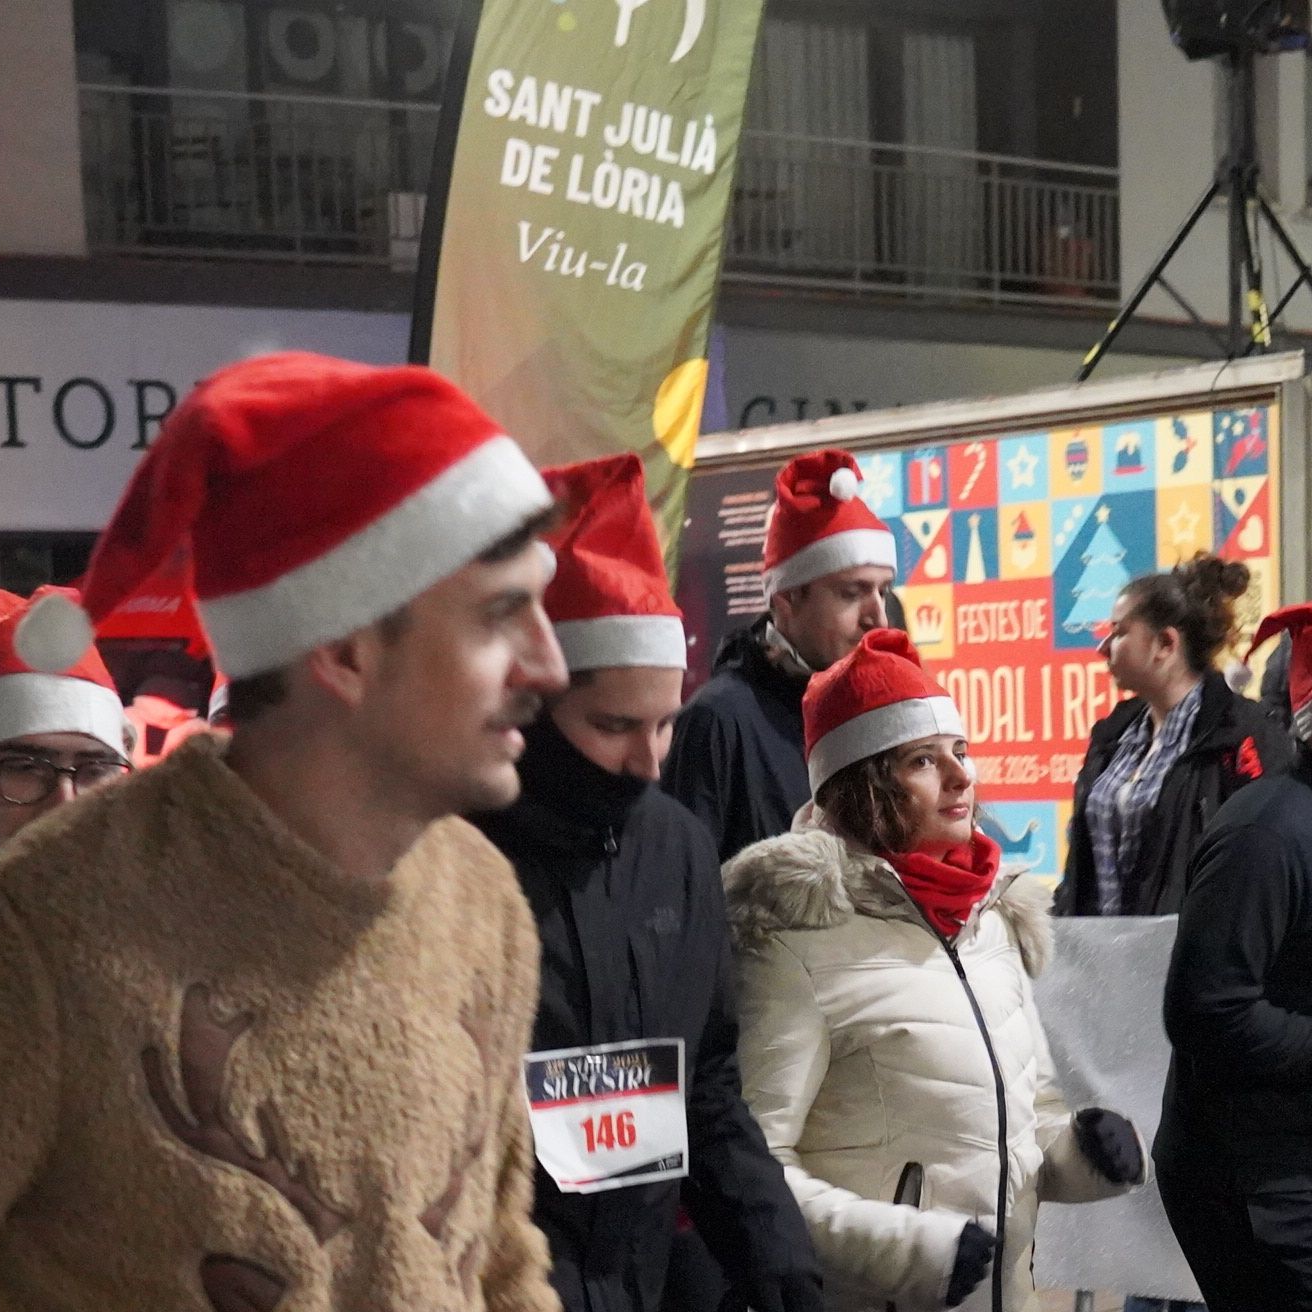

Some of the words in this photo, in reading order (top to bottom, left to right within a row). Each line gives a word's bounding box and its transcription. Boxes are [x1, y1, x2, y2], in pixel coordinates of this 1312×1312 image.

[484, 69, 602, 137] SANT
[604, 103, 717, 175] JULIÀ
[501, 138, 560, 195] DE
[566, 149, 685, 229] LÒRIA
[518, 220, 647, 291] Viu-la
[957, 601, 1021, 645] FESTES
[1022, 597, 1049, 640] DE
[937, 665, 1035, 744] ADAL
[1041, 664, 1054, 741] I
[1063, 660, 1137, 742] RE
[580, 1111, 637, 1152] 146
